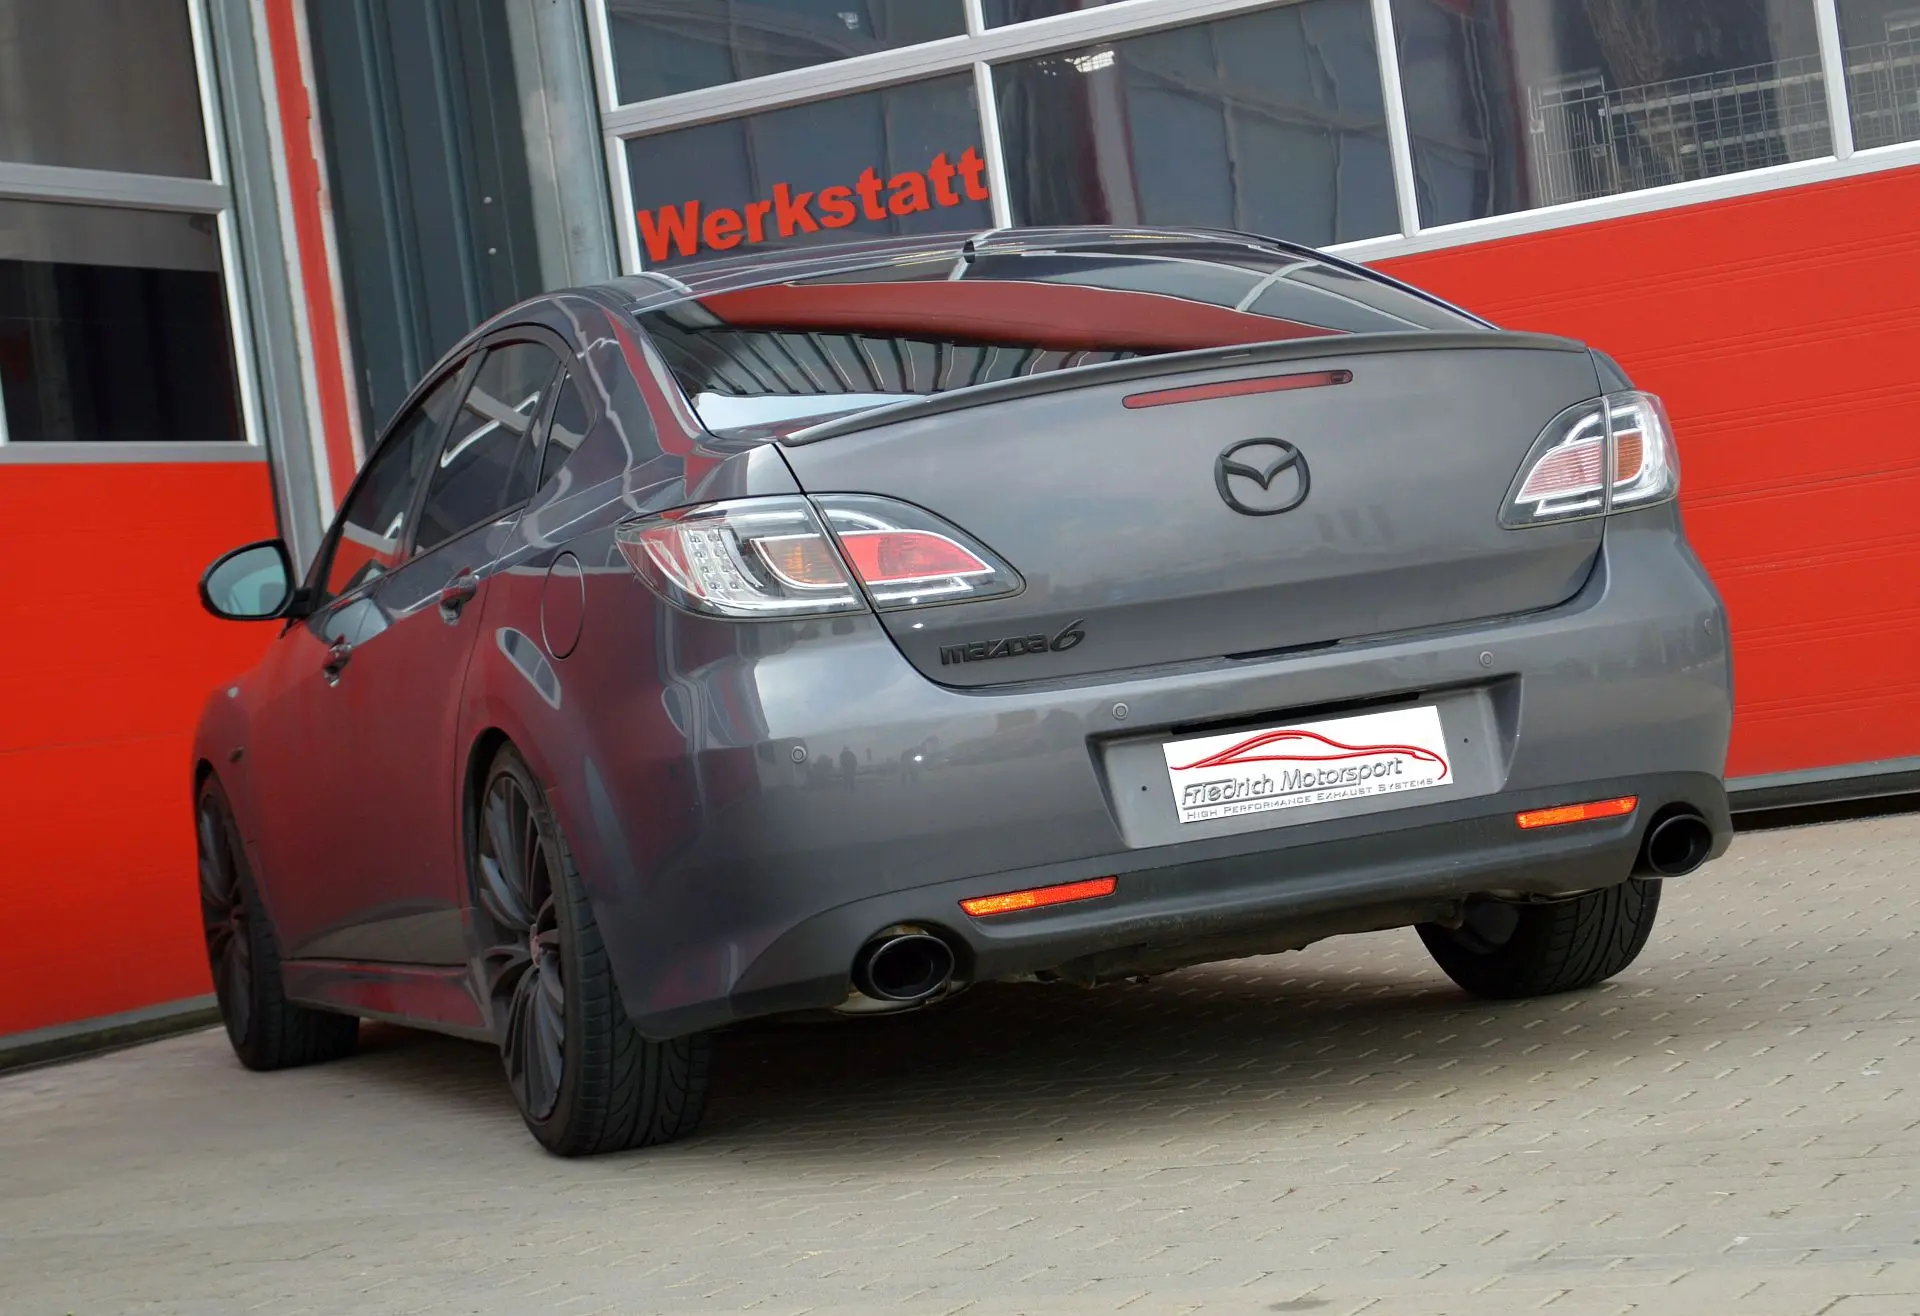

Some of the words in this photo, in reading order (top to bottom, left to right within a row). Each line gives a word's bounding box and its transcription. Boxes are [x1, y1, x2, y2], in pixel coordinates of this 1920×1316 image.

[637, 146, 989, 262] Werkstatt
[1182, 773, 1274, 806] Friedrich
[1280, 757, 1403, 791] Motorsport
[1187, 808, 1218, 820] HIGH
[1223, 795, 1312, 815] PERFORMANCE
[1317, 786, 1373, 801] EXHAUST
[1378, 778, 1433, 792] SYSTEMS
